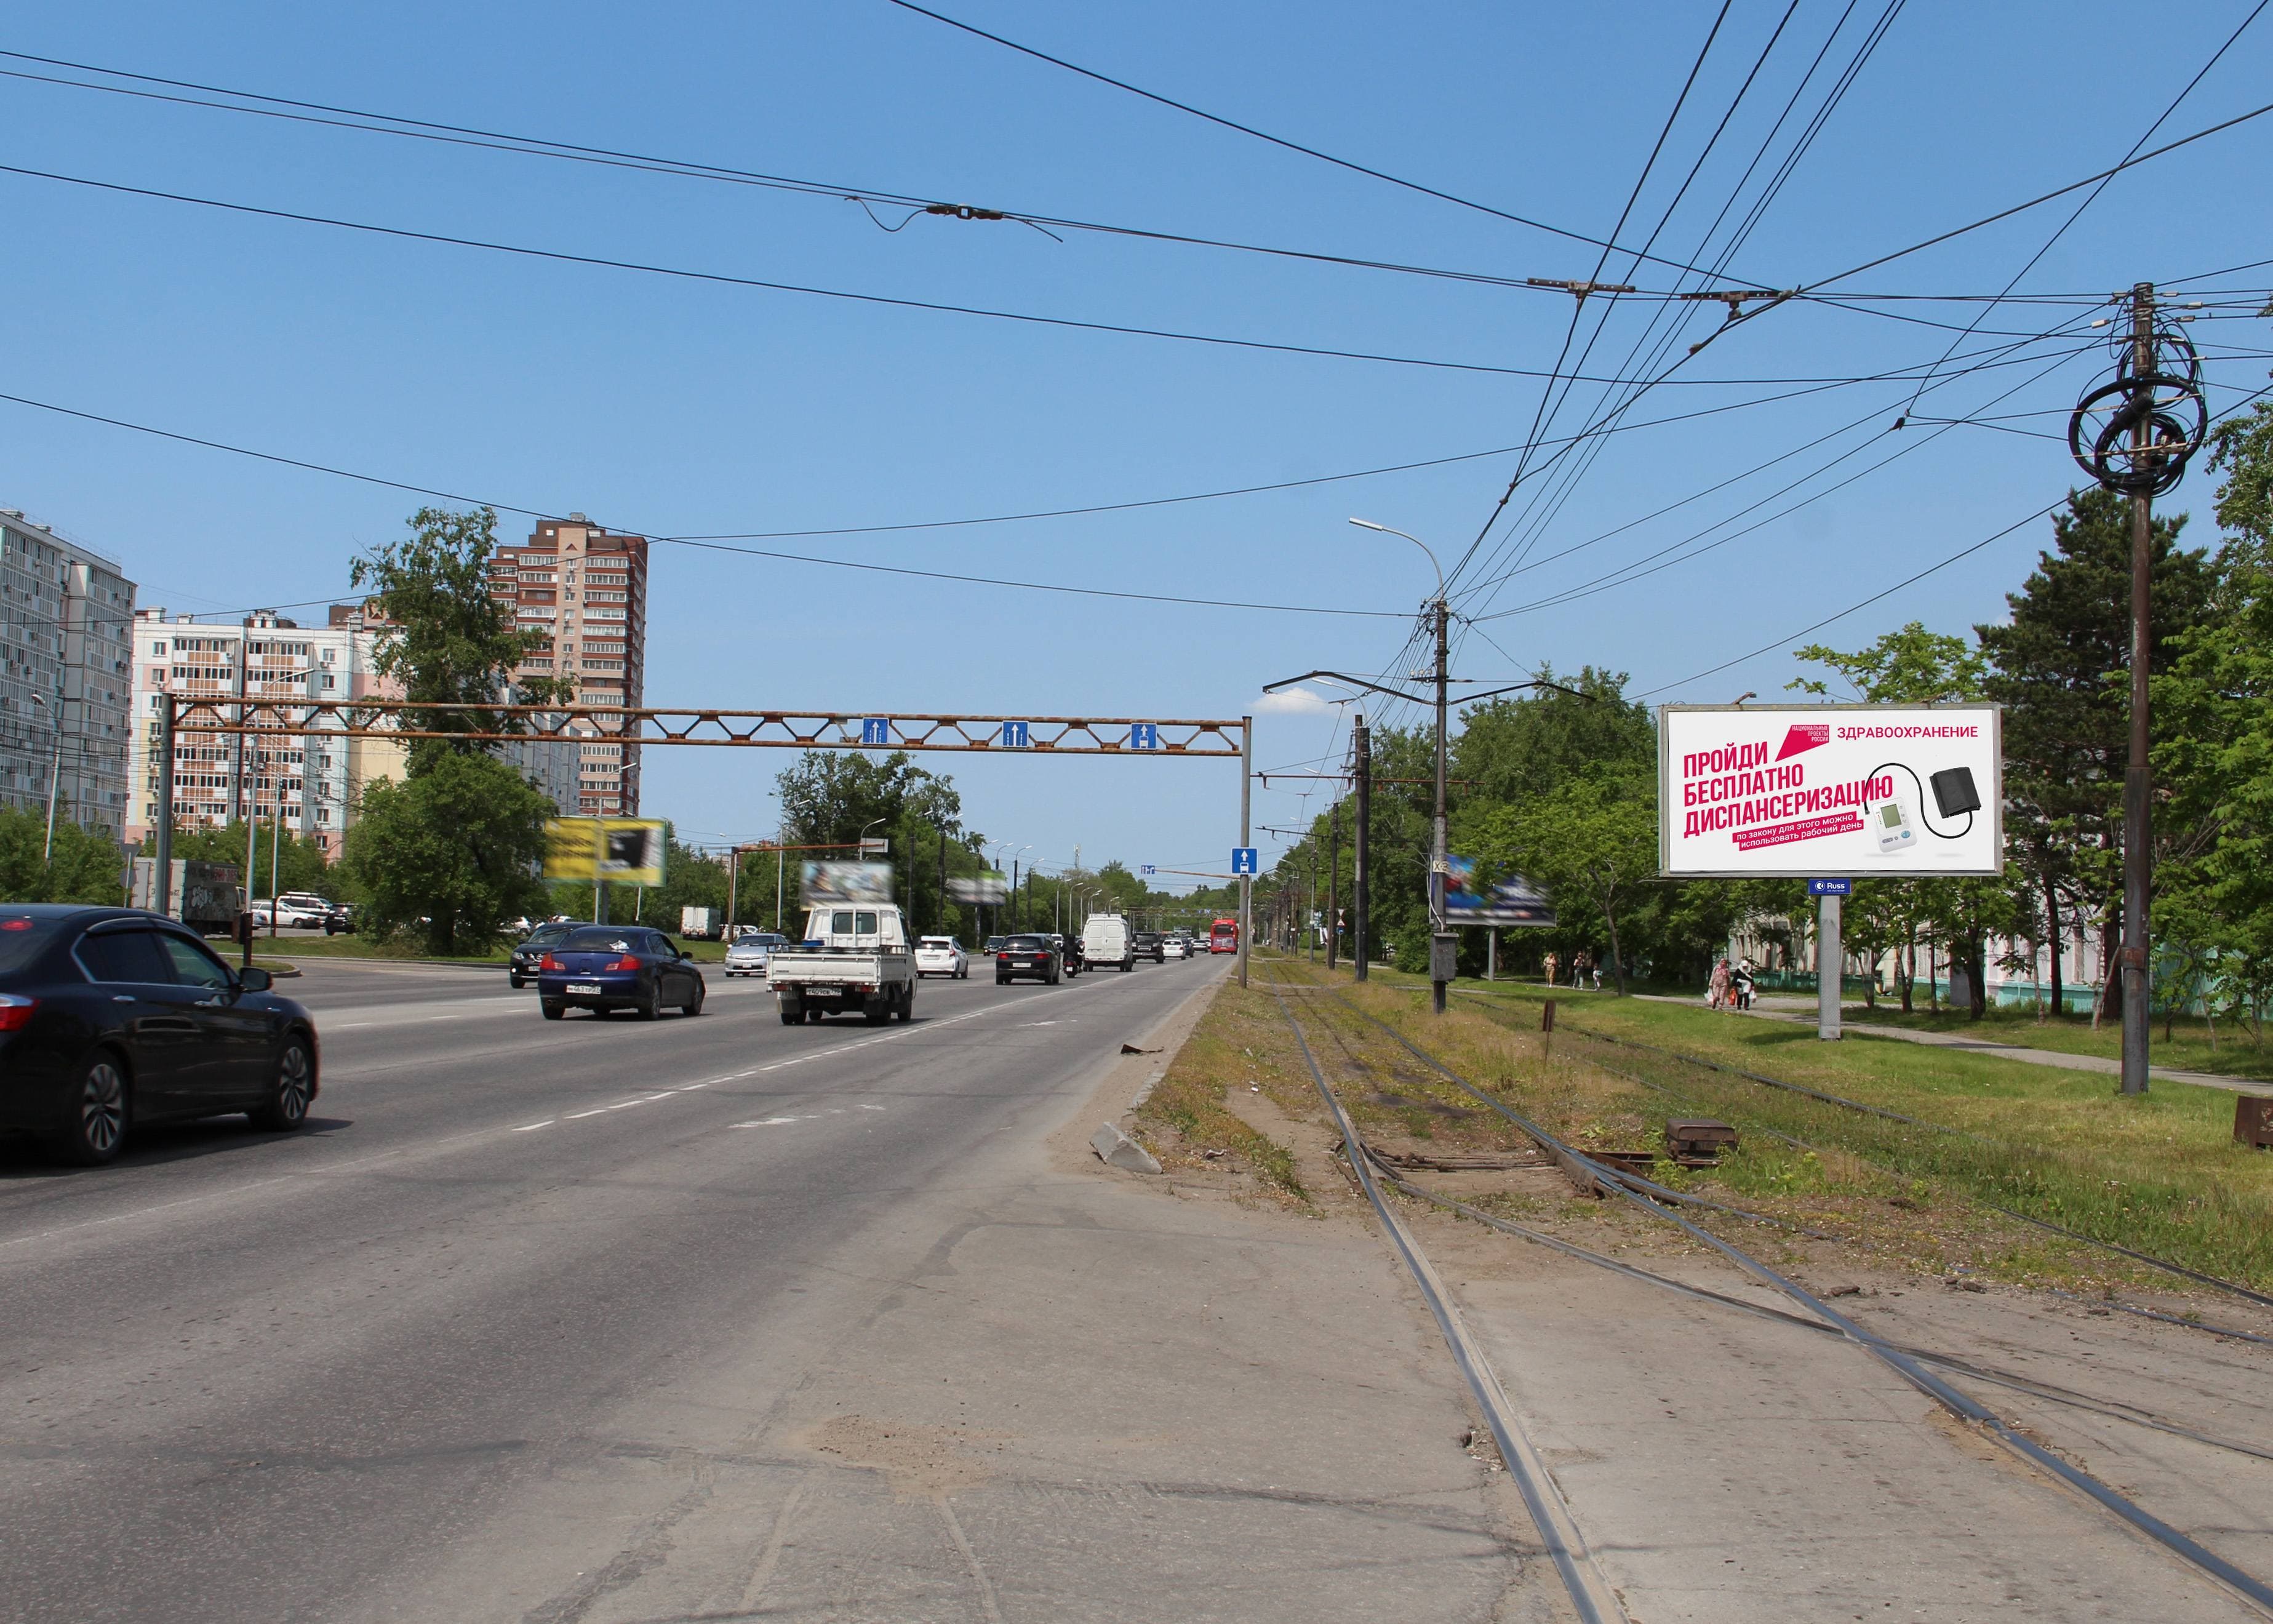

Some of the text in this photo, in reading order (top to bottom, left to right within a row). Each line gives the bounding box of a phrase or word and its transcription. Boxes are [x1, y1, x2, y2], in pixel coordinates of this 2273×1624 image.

[1837, 726, 1978, 740] ЗДРАВООХРАНЕНИЕ
[1684, 742, 1768, 778] ПРОЙДИ
[1684, 764, 1804, 807] БЕСПЛАТНО
[1684, 775, 1893, 839] ДИСПАНСЕРИЗАЦИЮ
[1741, 822, 1862, 848] использовать рабочий день
[1748, 828, 1777, 838] закону
[1778, 825, 1794, 834] для
[1797, 820, 1820, 830] этого
[1822, 814, 1853, 825] можно
